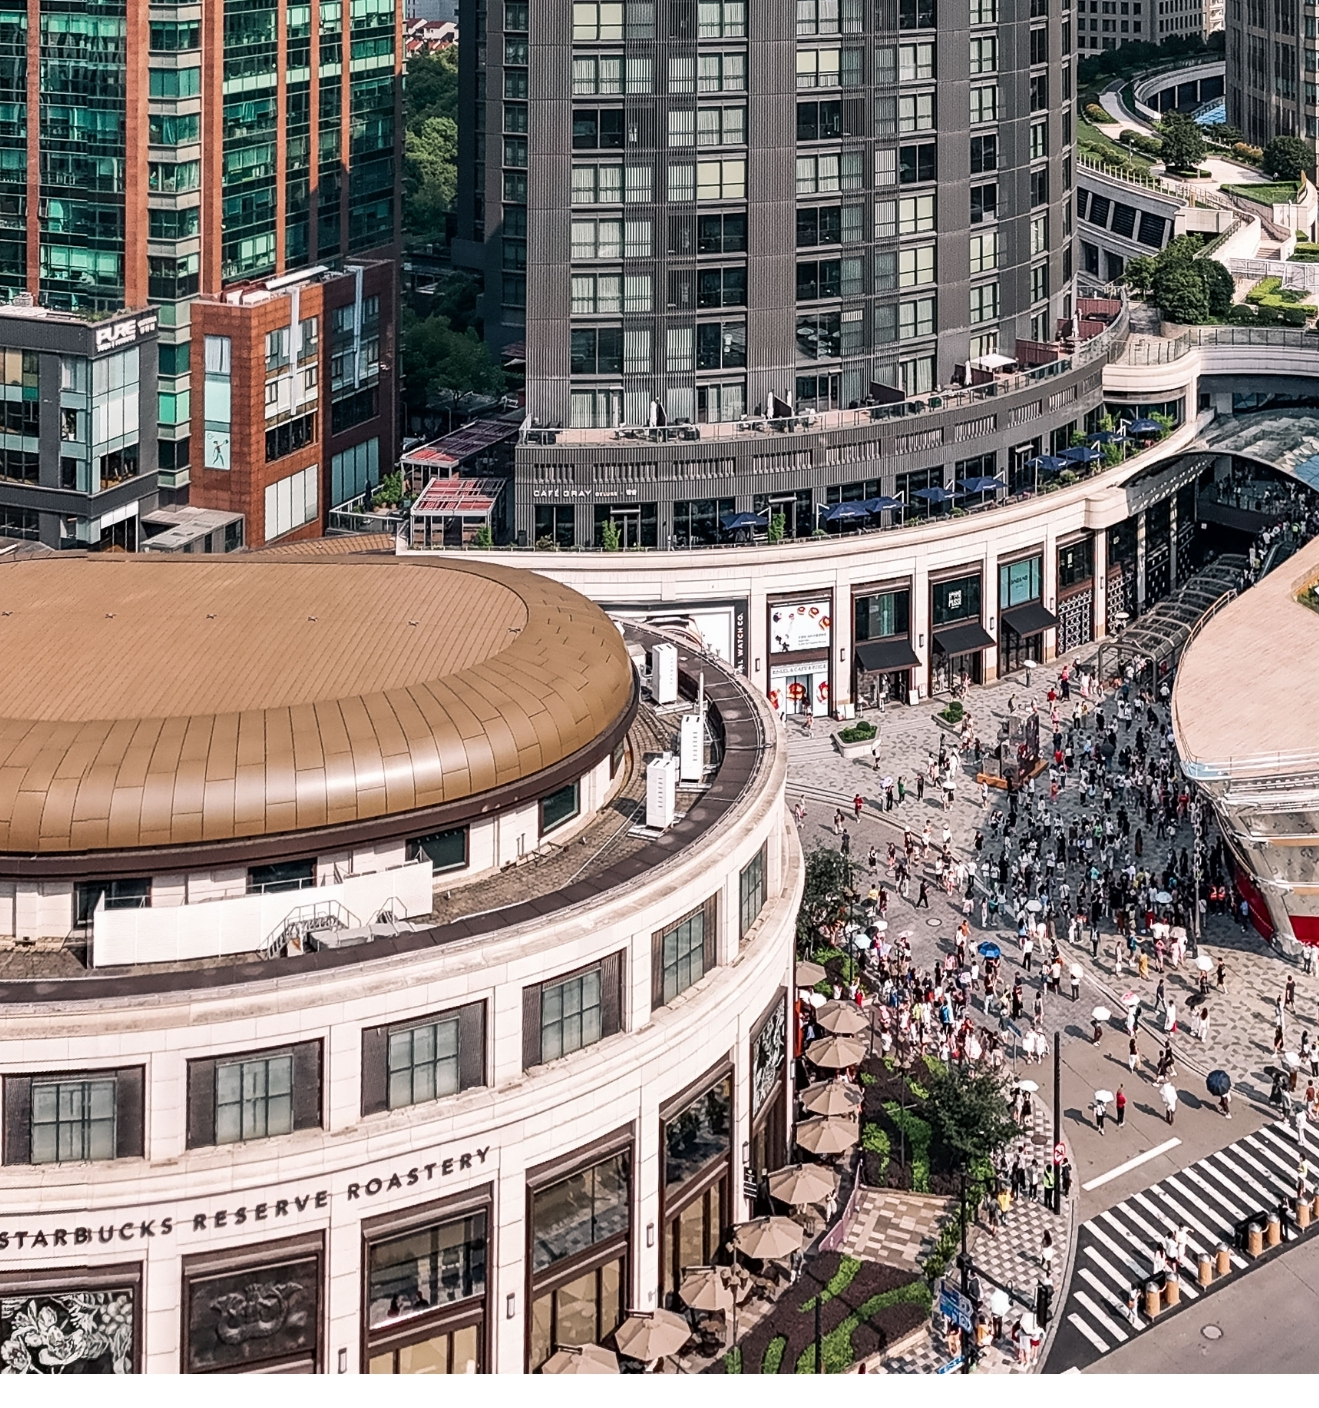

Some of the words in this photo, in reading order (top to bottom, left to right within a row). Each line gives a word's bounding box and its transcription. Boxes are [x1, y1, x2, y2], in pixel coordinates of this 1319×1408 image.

[95, 319, 136, 347] PURE
[192, 1190, 329, 1232] RESERVE
[346, 1145, 491, 1201] ROASTERY
